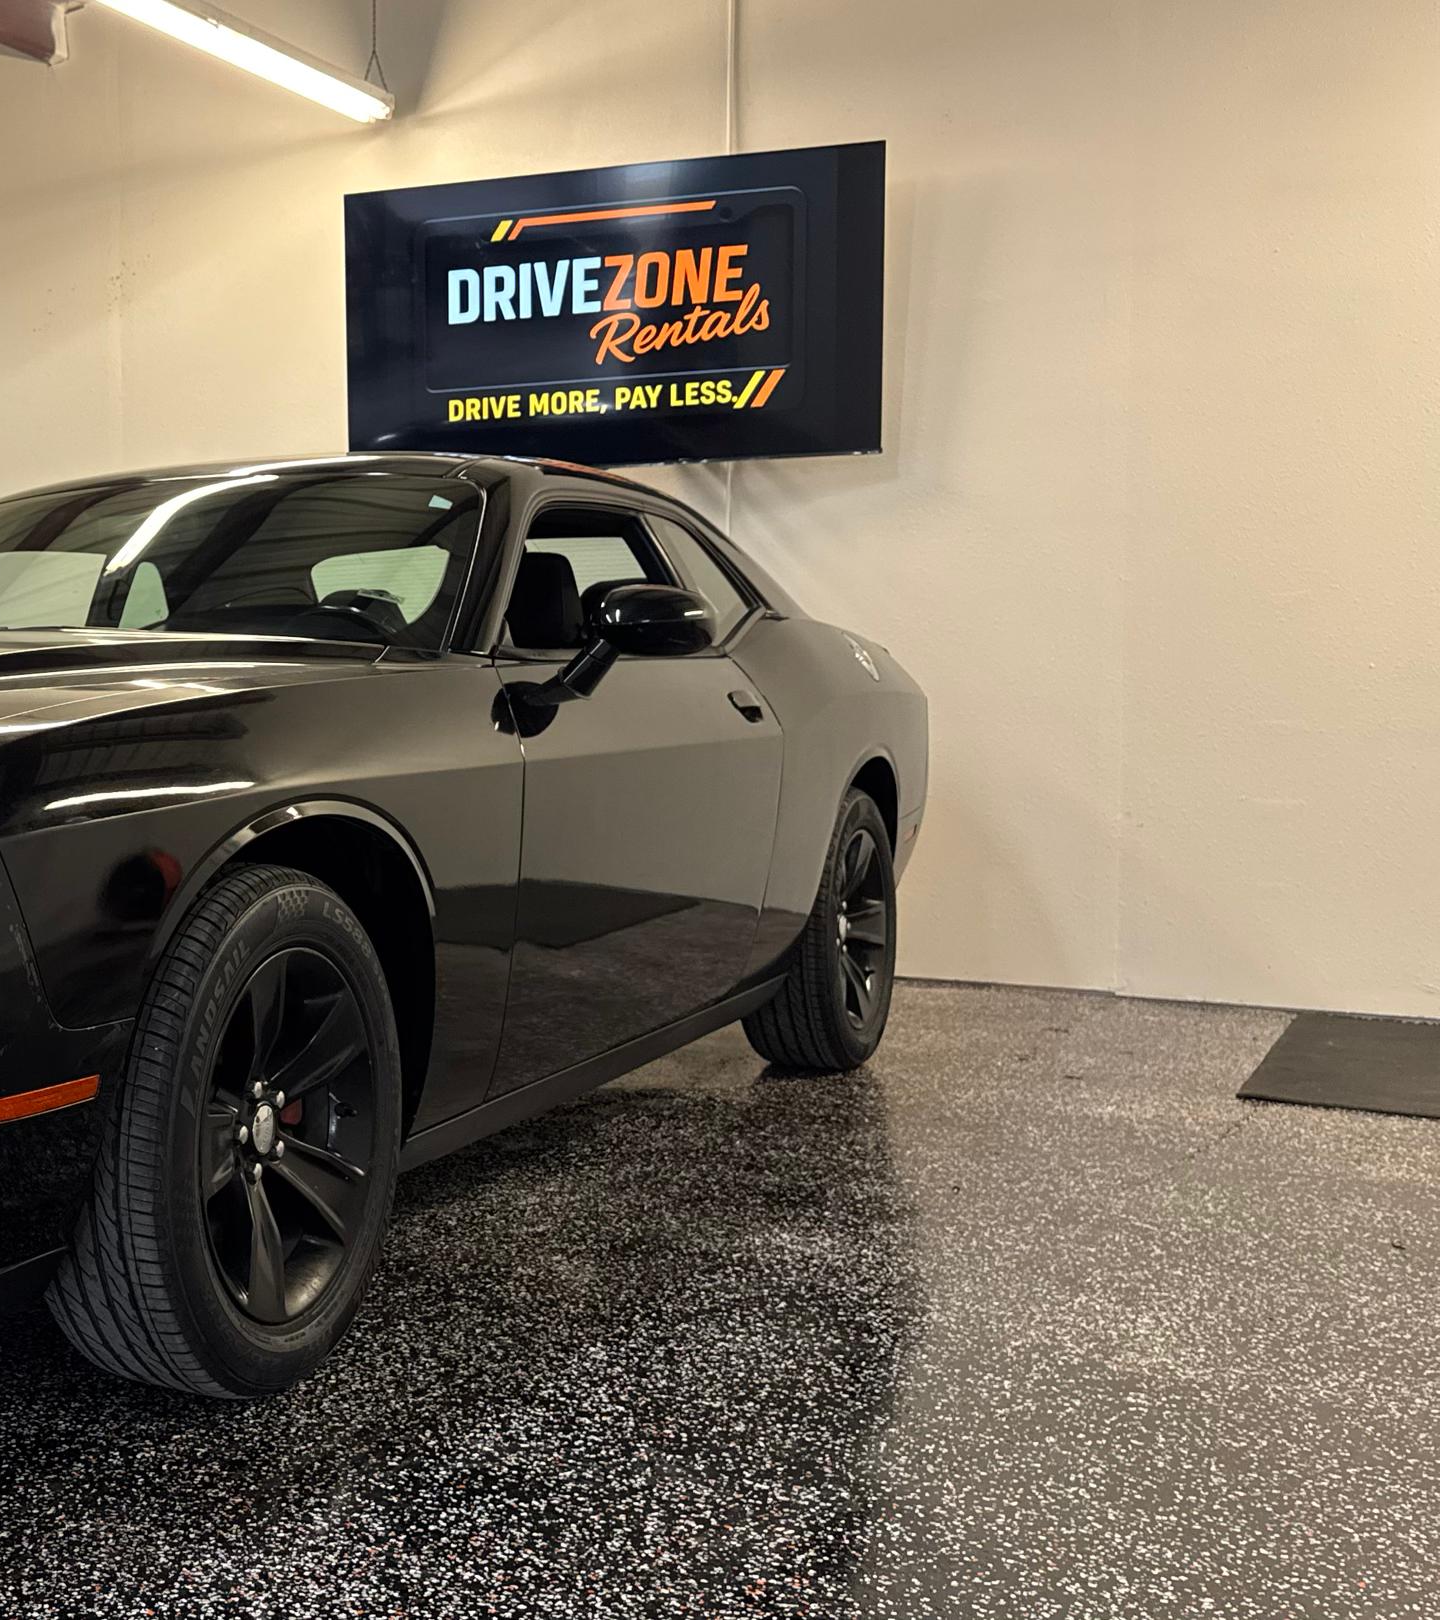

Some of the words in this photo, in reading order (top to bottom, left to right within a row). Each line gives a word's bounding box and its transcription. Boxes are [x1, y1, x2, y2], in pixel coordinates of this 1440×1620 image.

[447, 243, 749, 326] DRIVEZONE
[589, 282, 770, 365] Rentals
[448, 394, 520, 422] DRIVE
[528, 388, 607, 415] MORE,
[614, 384, 662, 409] PAY
